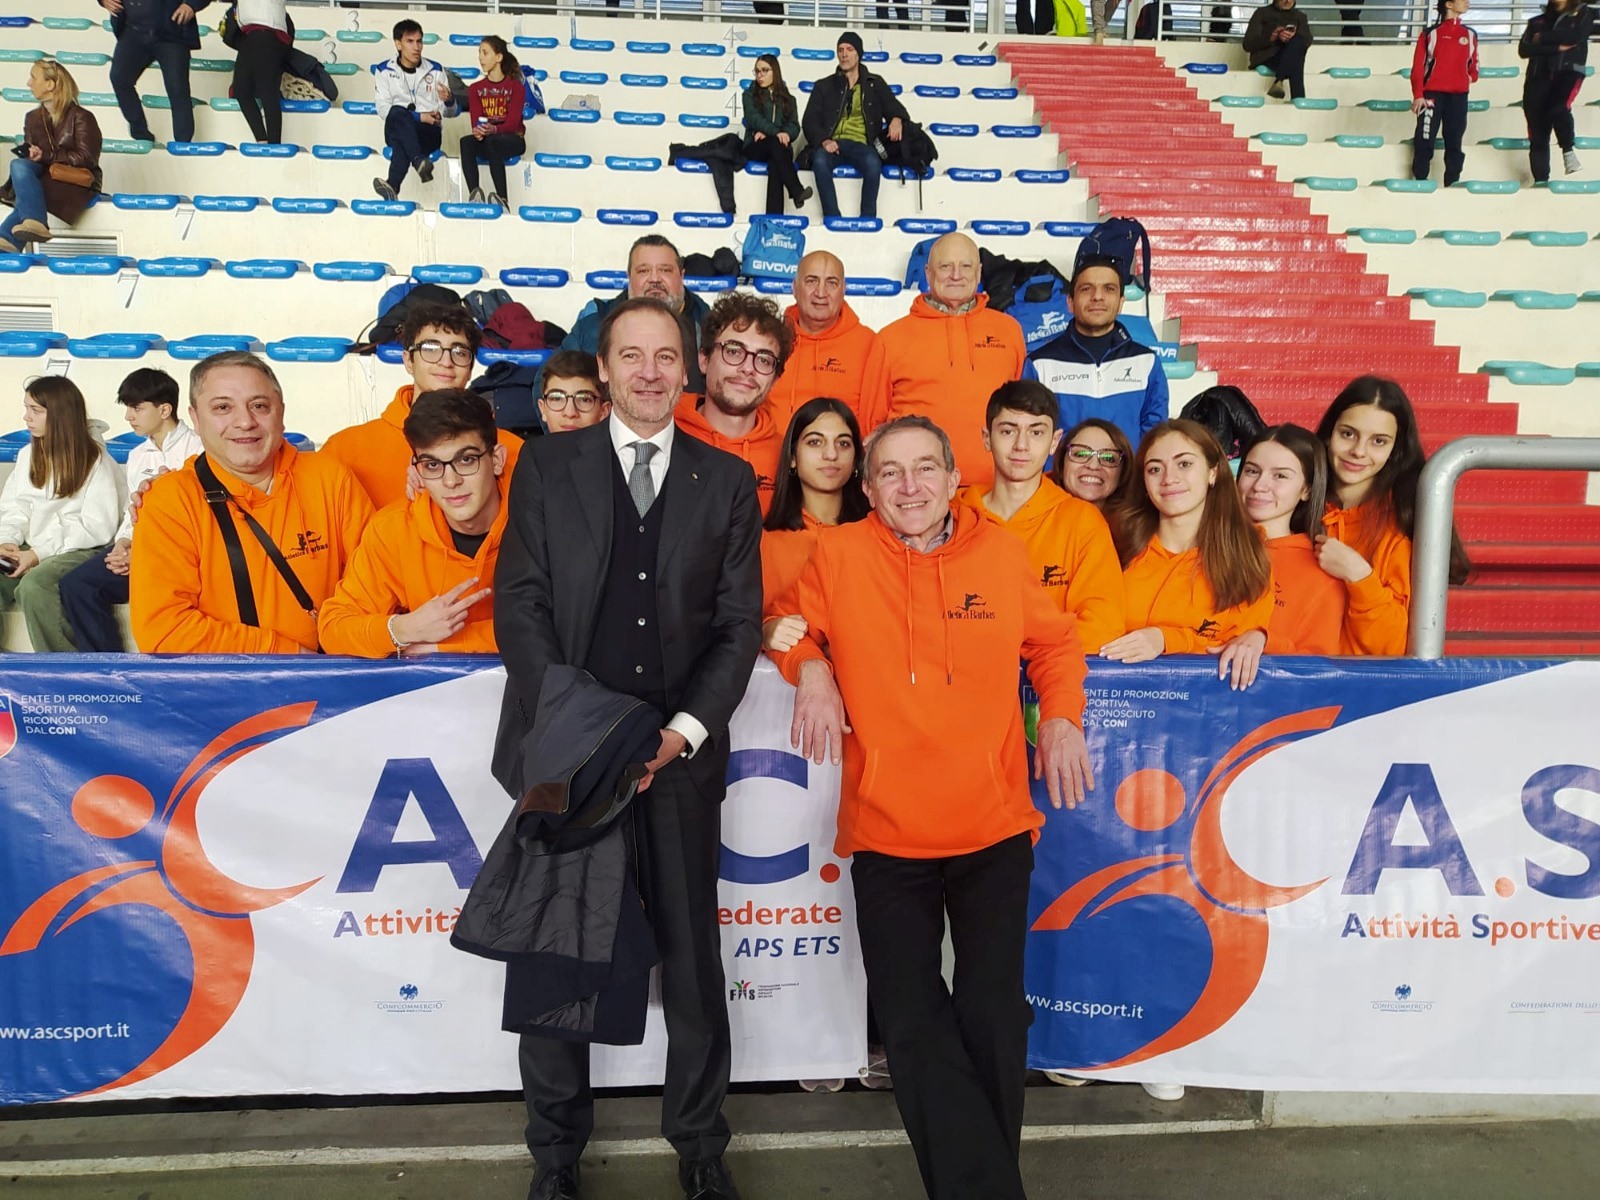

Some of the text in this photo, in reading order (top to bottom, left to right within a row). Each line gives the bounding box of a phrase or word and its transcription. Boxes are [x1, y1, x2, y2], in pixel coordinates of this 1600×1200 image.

[724, 57, 740, 82] 4
[725, 92, 742, 118] 4
[175, 207, 196, 241] 7
[117, 272, 140, 309] 7
[1051, 373, 1090, 382] GIVOVA
[21, 694, 143, 704] ENTE DI PROMOZIONE
[1083, 688, 1190, 700] ENTE DI PROMOZIONE
[21, 705, 78, 715] SPORTIVA
[1082, 708, 1156, 719] RICONOSCIUTO
[23, 715, 109, 725] RICONOSCIUTO
[1082, 719, 1128, 728] DAL CONI
[26, 726, 77, 735] DAL CONI
[718, 900, 842, 926] ederate
[1340, 912, 1600, 947] Attività Sportive
[734, 935, 841, 958] APS ETS
